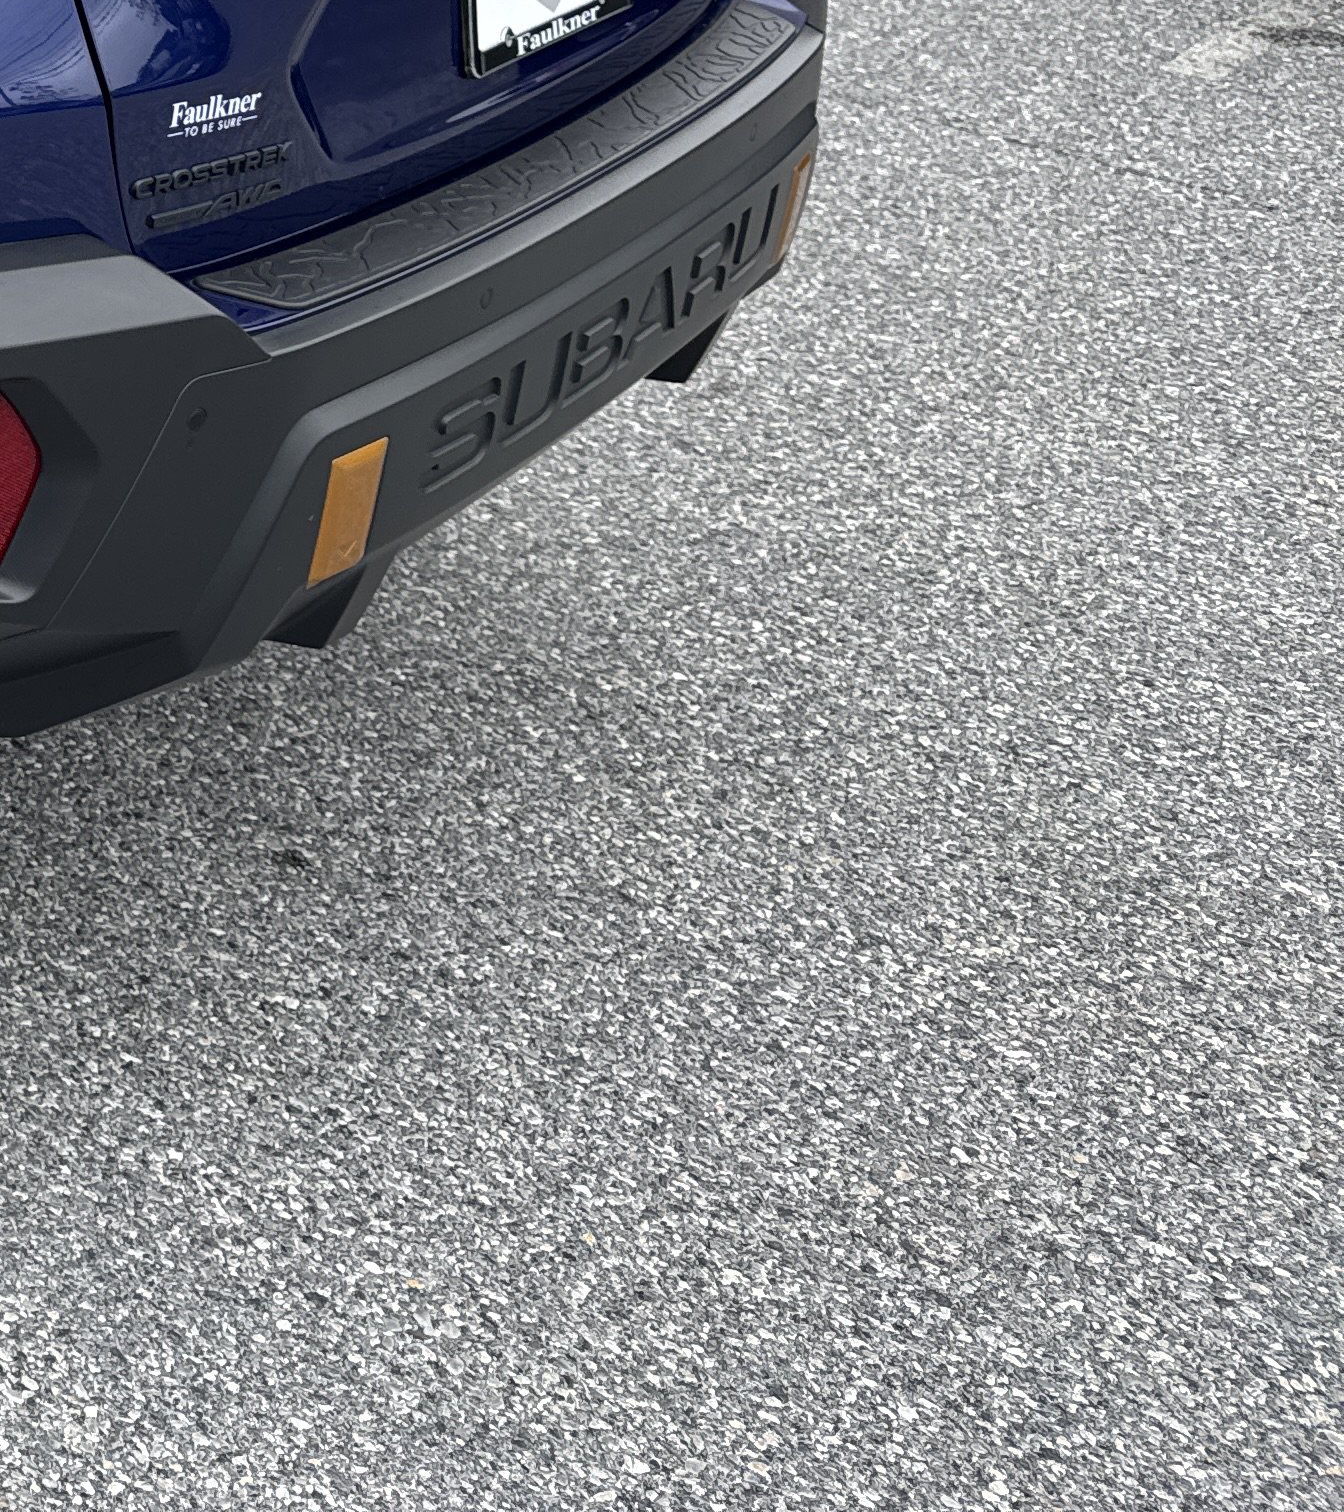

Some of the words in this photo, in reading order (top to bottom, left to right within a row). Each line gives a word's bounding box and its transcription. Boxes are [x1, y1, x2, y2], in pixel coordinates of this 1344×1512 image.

[515, 4, 602, 56] Faulkner
[168, 92, 262, 129] Faulkner
[184, 125, 199, 138] TO
[201, 122, 214, 135] BE
[217, 115, 243, 132] SURE
[129, 140, 293, 200] CROSSTREK
[202, 178, 283, 218] AWD
[422, 183, 780, 495] SUBARU
